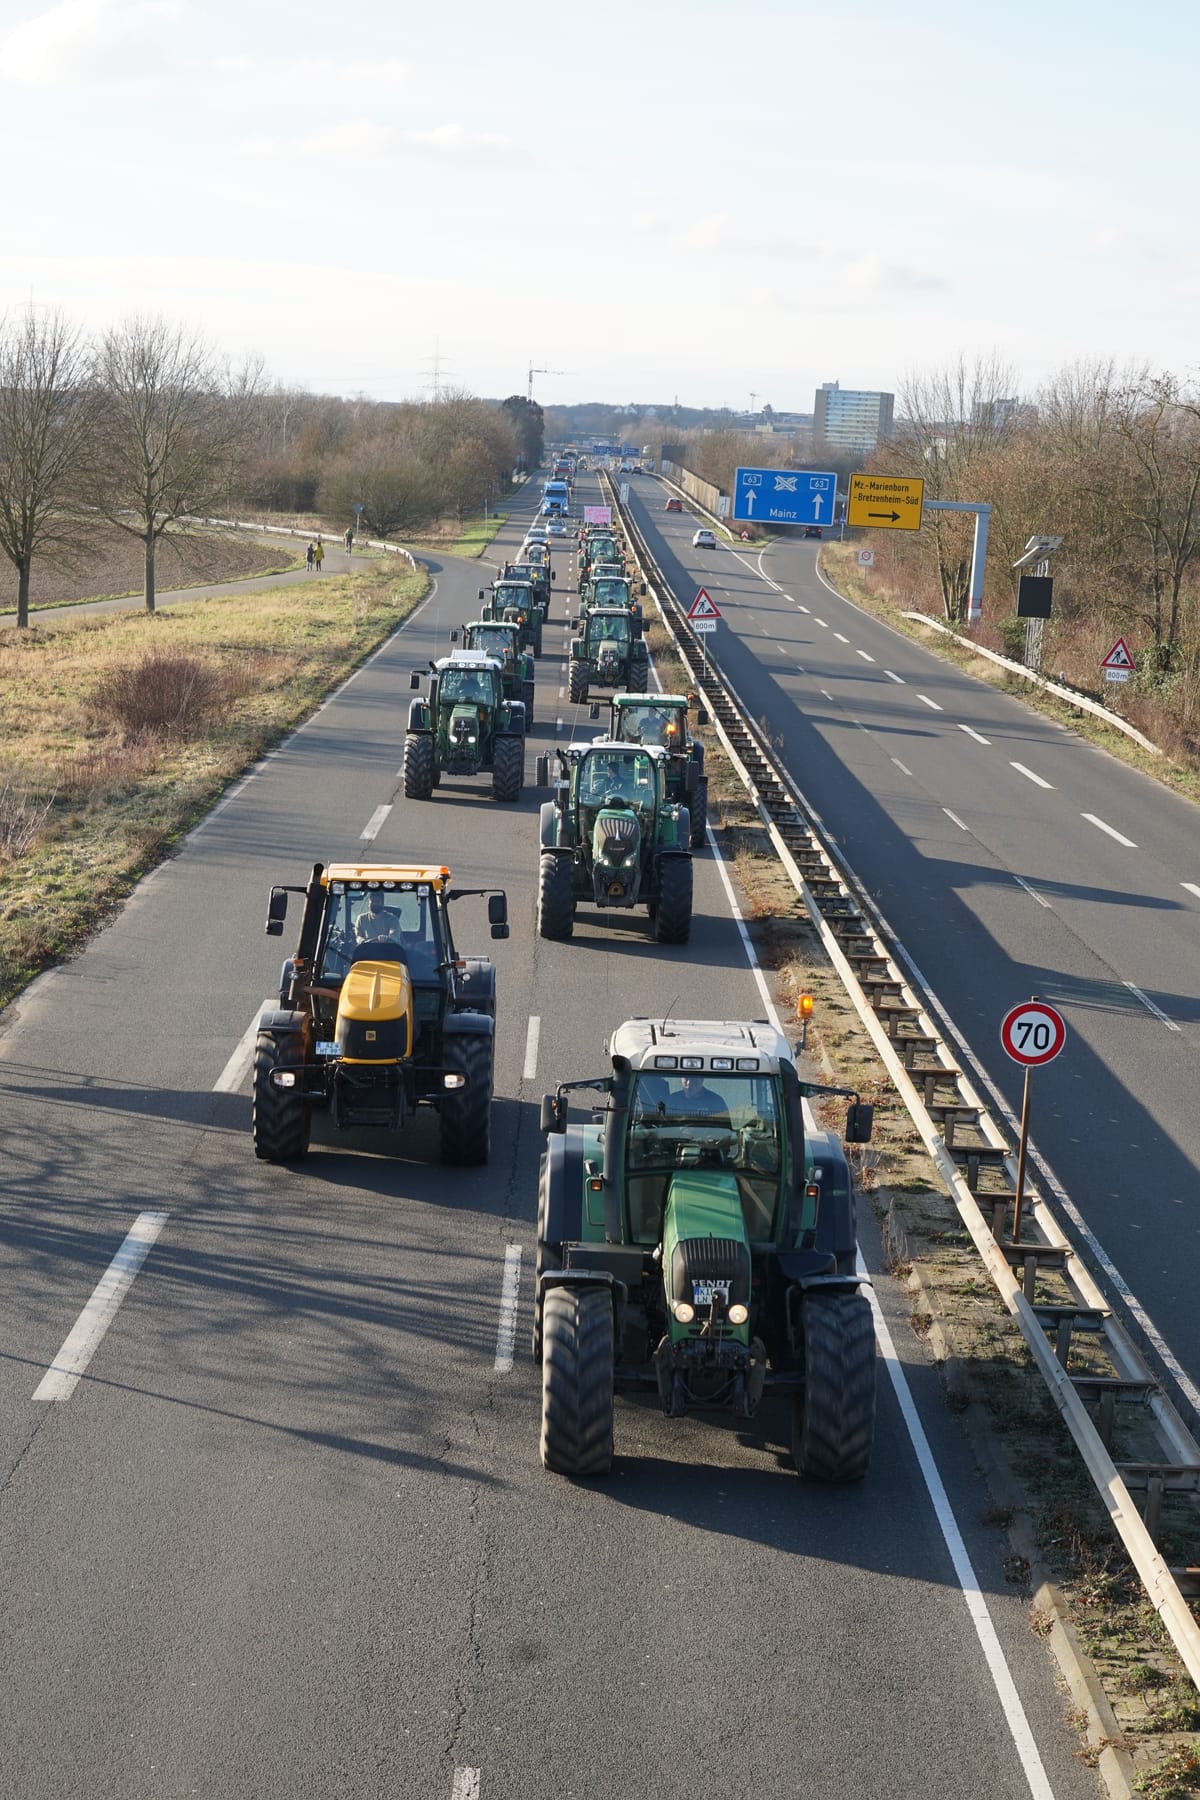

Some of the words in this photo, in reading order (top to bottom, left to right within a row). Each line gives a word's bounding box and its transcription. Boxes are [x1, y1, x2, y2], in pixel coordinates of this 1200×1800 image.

[747, 475, 757, 484] 63
[814, 480, 824, 488] 63
[769, 508, 798, 519] Mainz
[1017, 1022, 1050, 1050] 70
[691, 1279, 733, 1288] FENDT
